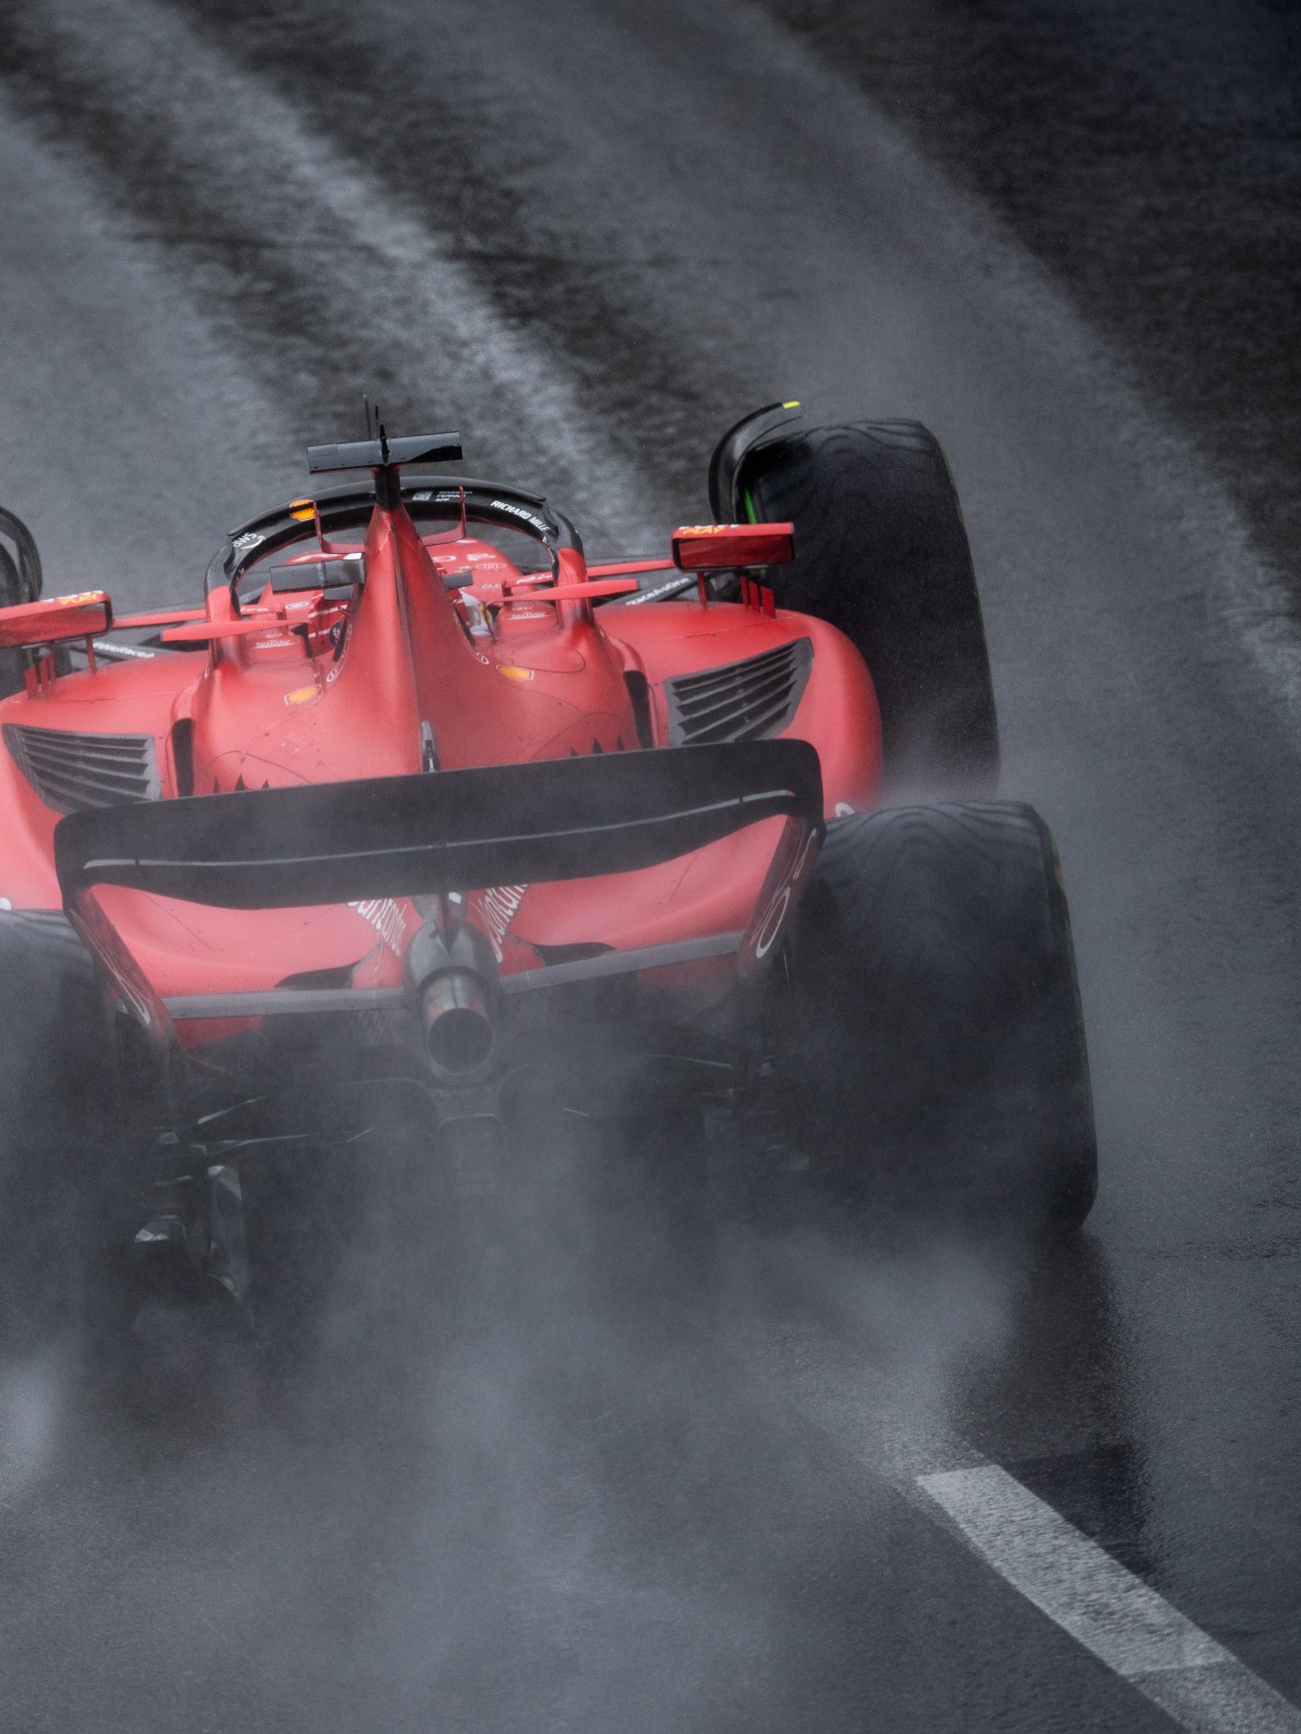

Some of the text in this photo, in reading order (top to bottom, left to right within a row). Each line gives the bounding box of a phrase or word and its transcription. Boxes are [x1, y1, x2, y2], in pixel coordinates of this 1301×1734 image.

[490, 500, 550, 531] RICHARD MILLE
[683, 527, 724, 535] PLAY
